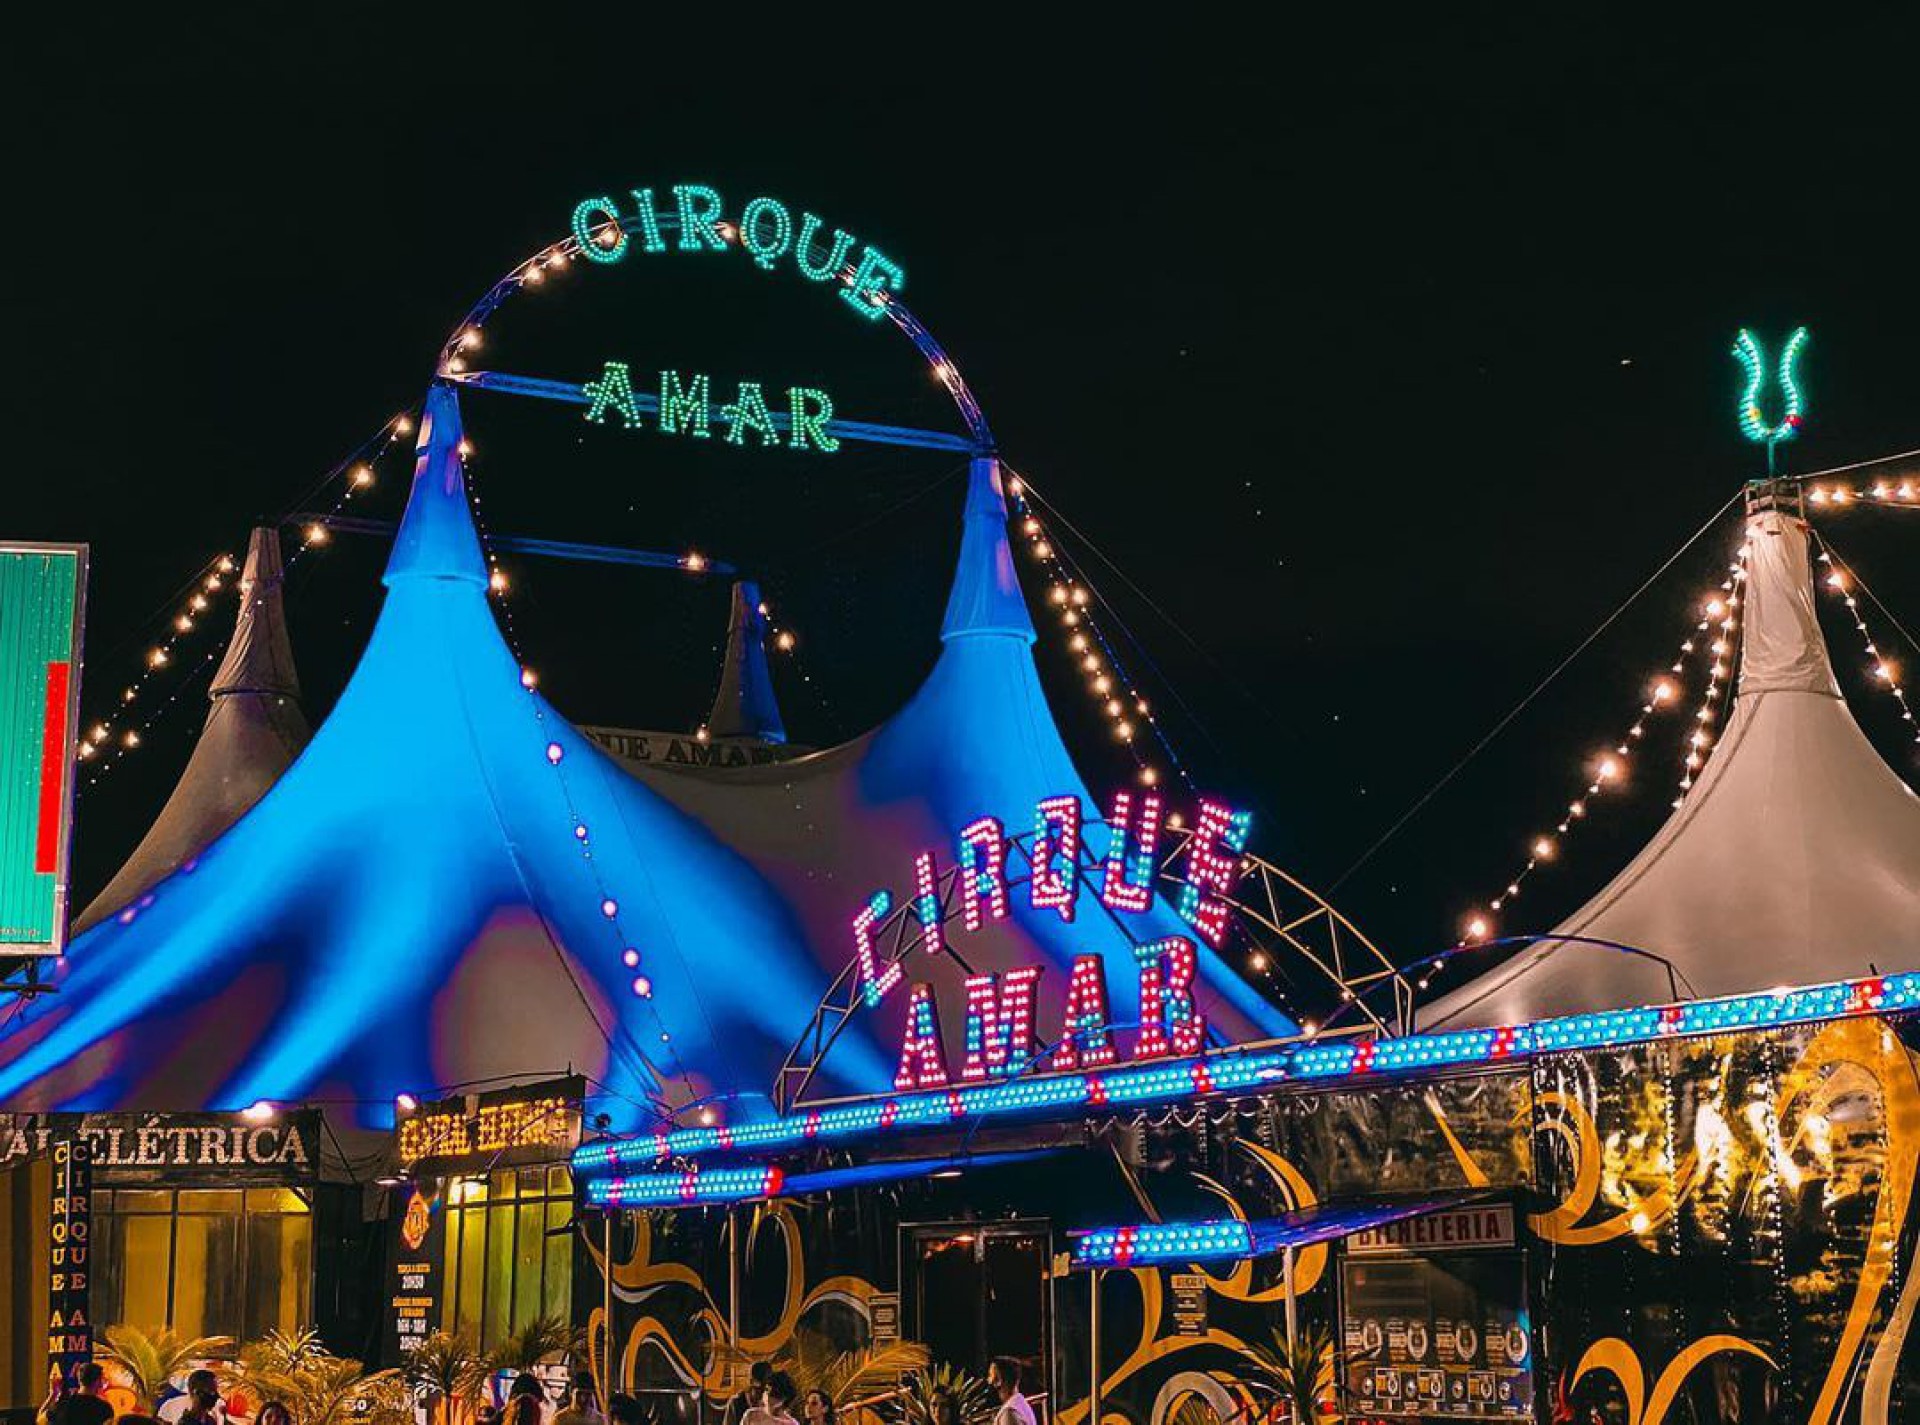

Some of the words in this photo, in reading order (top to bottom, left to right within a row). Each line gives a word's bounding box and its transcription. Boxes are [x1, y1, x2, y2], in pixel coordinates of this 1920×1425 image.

[572, 184, 904, 320] CIRQUE
[582, 361, 840, 452] AMAR
[852, 792, 1252, 1008] CIRQUE
[893, 935, 1206, 1091] AMAR
[52, 1146, 68, 1291] CIRQUE
[70, 1146, 87, 1291] CIRQUE
